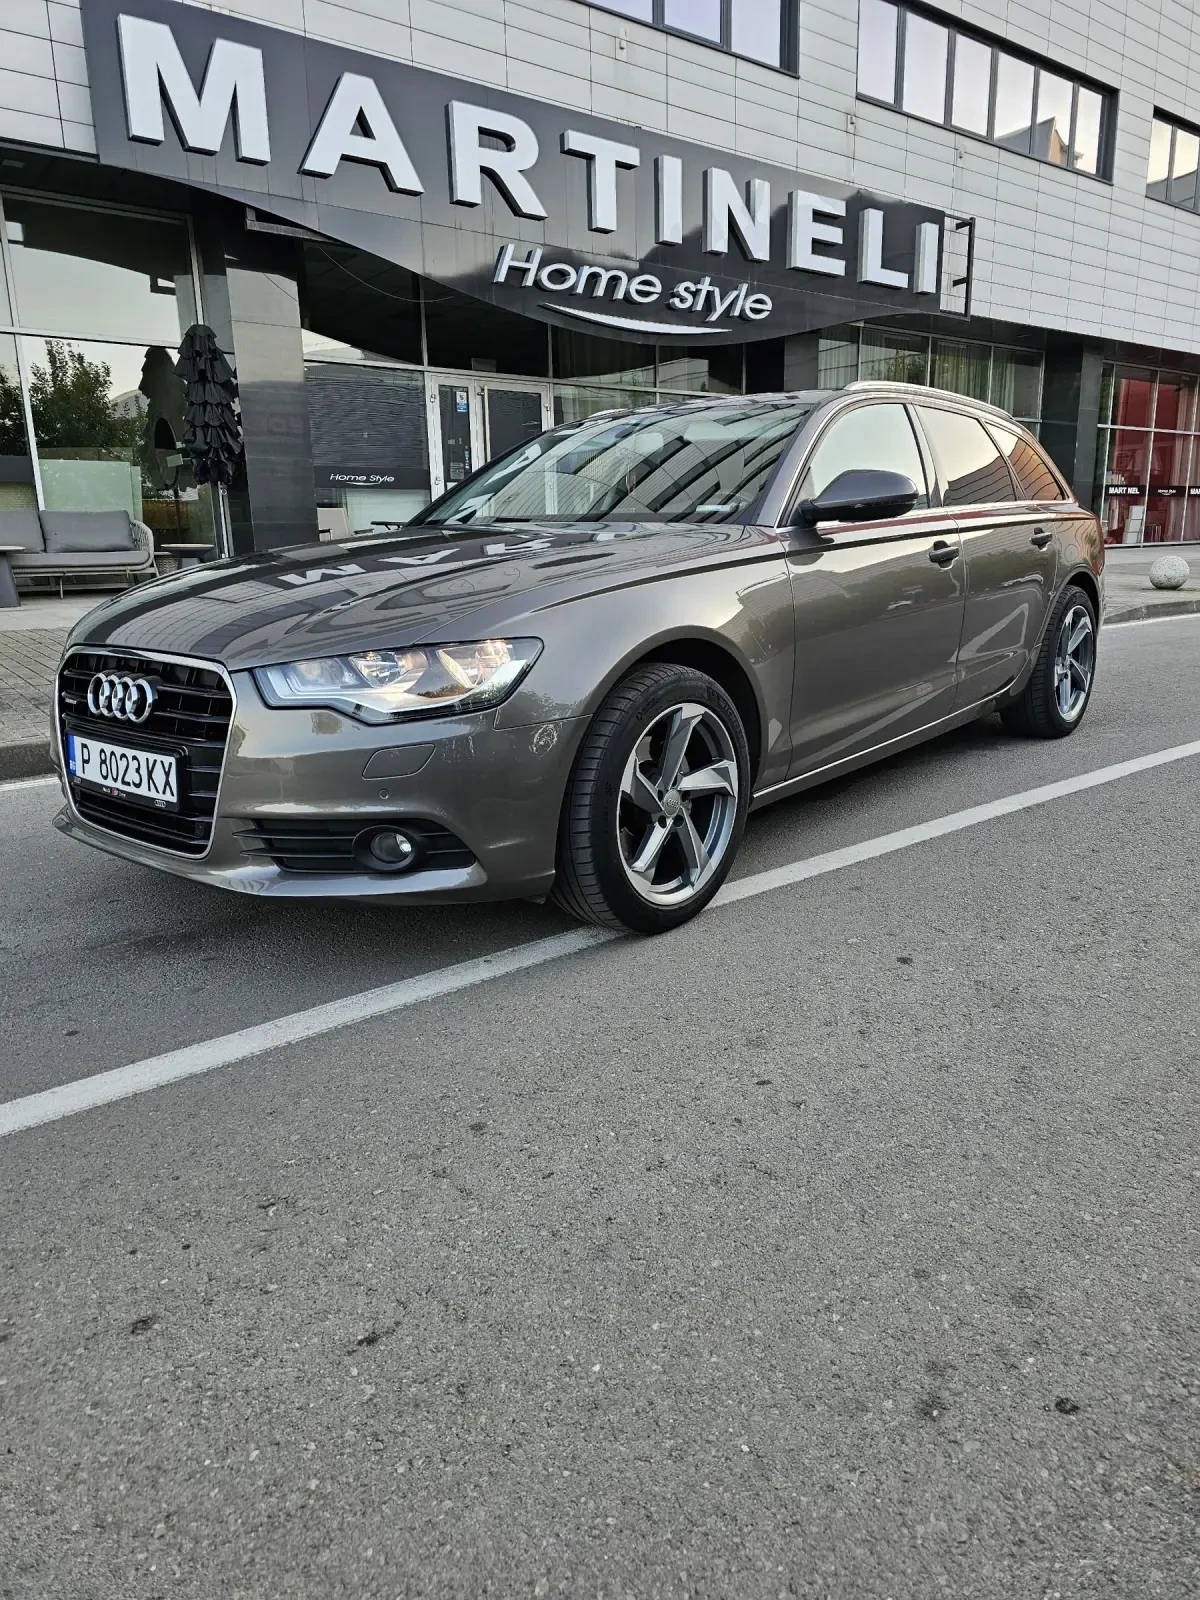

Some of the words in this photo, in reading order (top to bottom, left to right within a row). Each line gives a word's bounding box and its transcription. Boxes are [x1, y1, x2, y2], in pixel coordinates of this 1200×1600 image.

[117, 13, 940, 295] MARTINELI
[494, 243, 662, 303] Home
[668, 276, 773, 322] style
[329, 473, 367, 481] Home
[369, 474, 395, 484] Style
[81, 742, 91, 775] P
